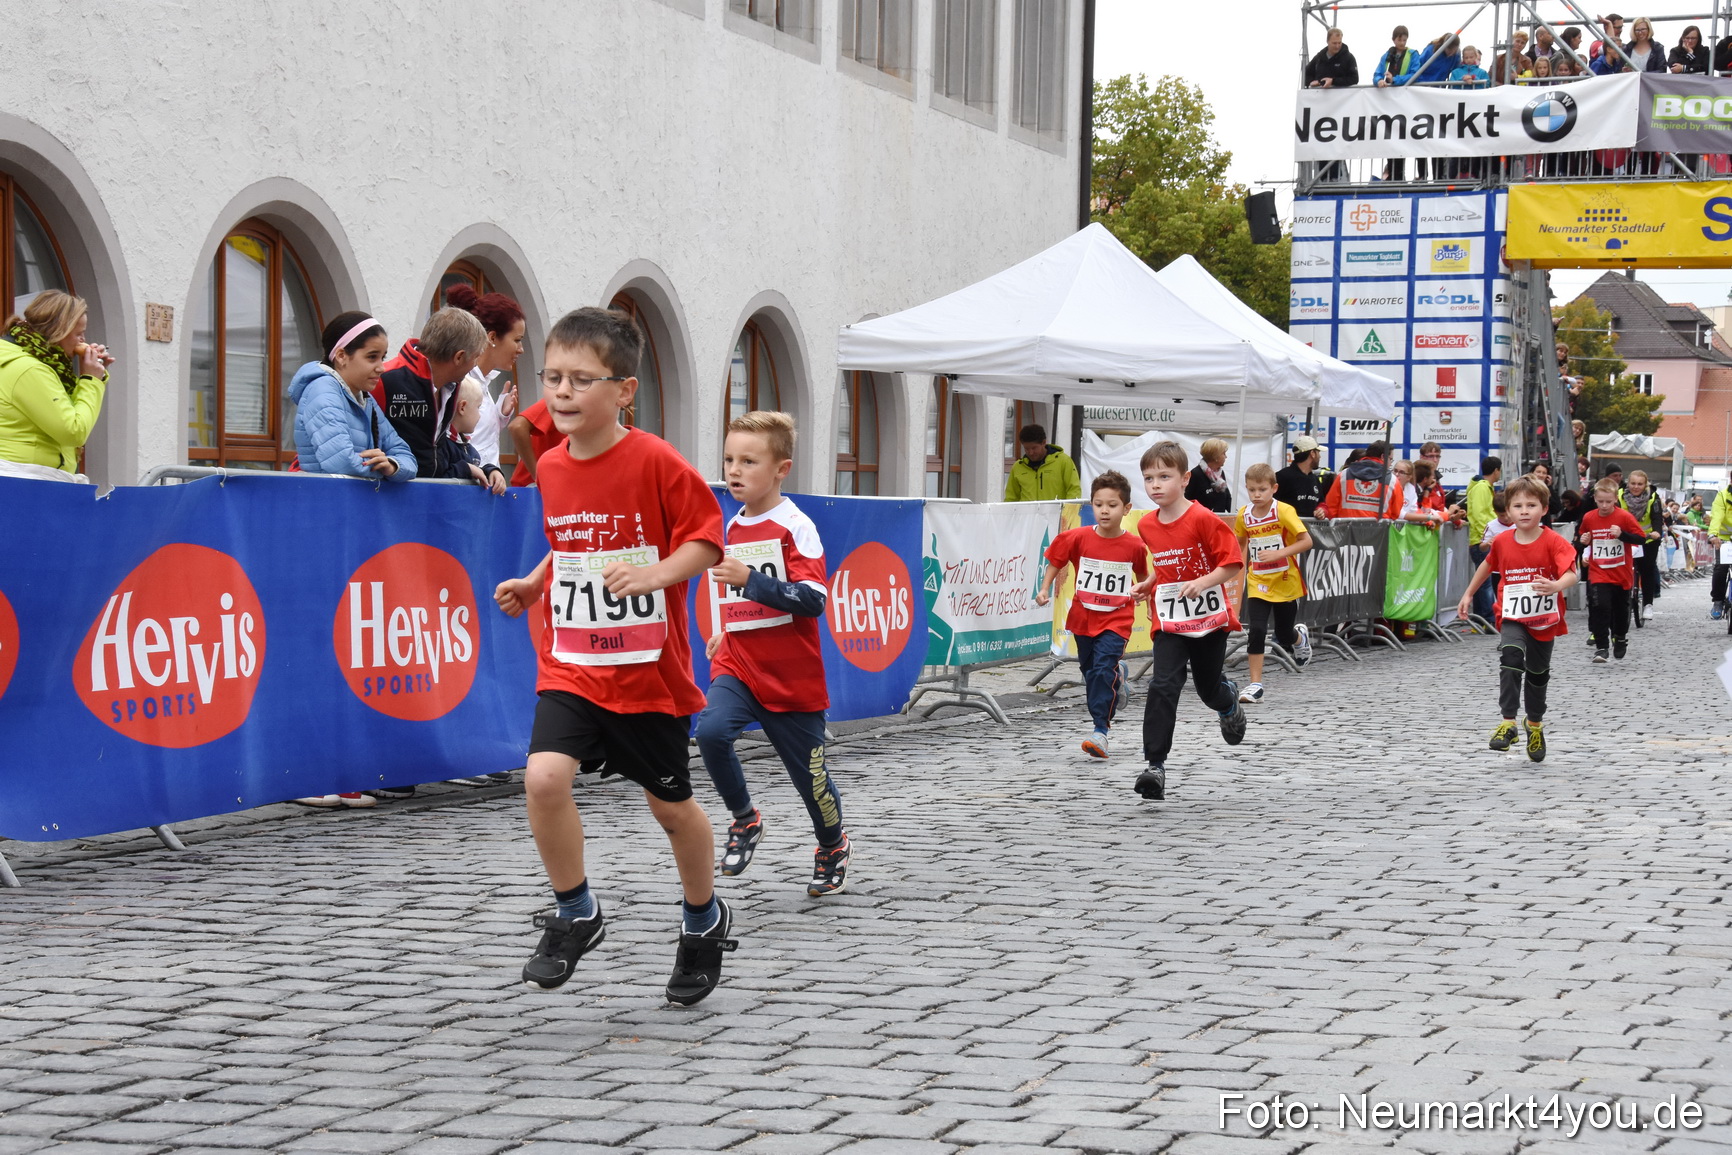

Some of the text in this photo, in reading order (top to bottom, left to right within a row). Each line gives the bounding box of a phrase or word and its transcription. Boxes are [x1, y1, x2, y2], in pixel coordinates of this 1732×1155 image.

[1527, 91, 1574, 110] BMW
[1650, 121, 1731, 132] inspired by smart
[1380, 215, 1405, 224] CLINIC
[1420, 214, 1465, 223] RAIL.ONE
[1538, 222, 1666, 234] Neumarkter Stadtlauf
[1348, 252, 1401, 261] Neumarkter Tagblatt
[1359, 297, 1404, 306] VARIOTEC
[389, 405, 428, 418] CAMP
[1339, 419, 1379, 431] swn
[547, 510, 609, 528] Neumarkter
[1597, 545, 1622, 557] 7142
[1083, 570, 1126, 593] 7161
[1094, 595, 1110, 604] Finn
[1162, 590, 1220, 619] 7126
[1509, 595, 1554, 615] 7075
[832, 570, 909, 646] Hervis
[1174, 618, 1218, 631] Sebastian
[349, 581, 473, 684] Hervis
[91, 590, 257, 704] Hervis
[589, 632, 625, 650] Paul
[843, 637, 881, 653] SPORTS
[363, 673, 432, 697] SPORTS
[111, 693, 196, 723] SPORTS
[717, 941, 733, 949] FILA
